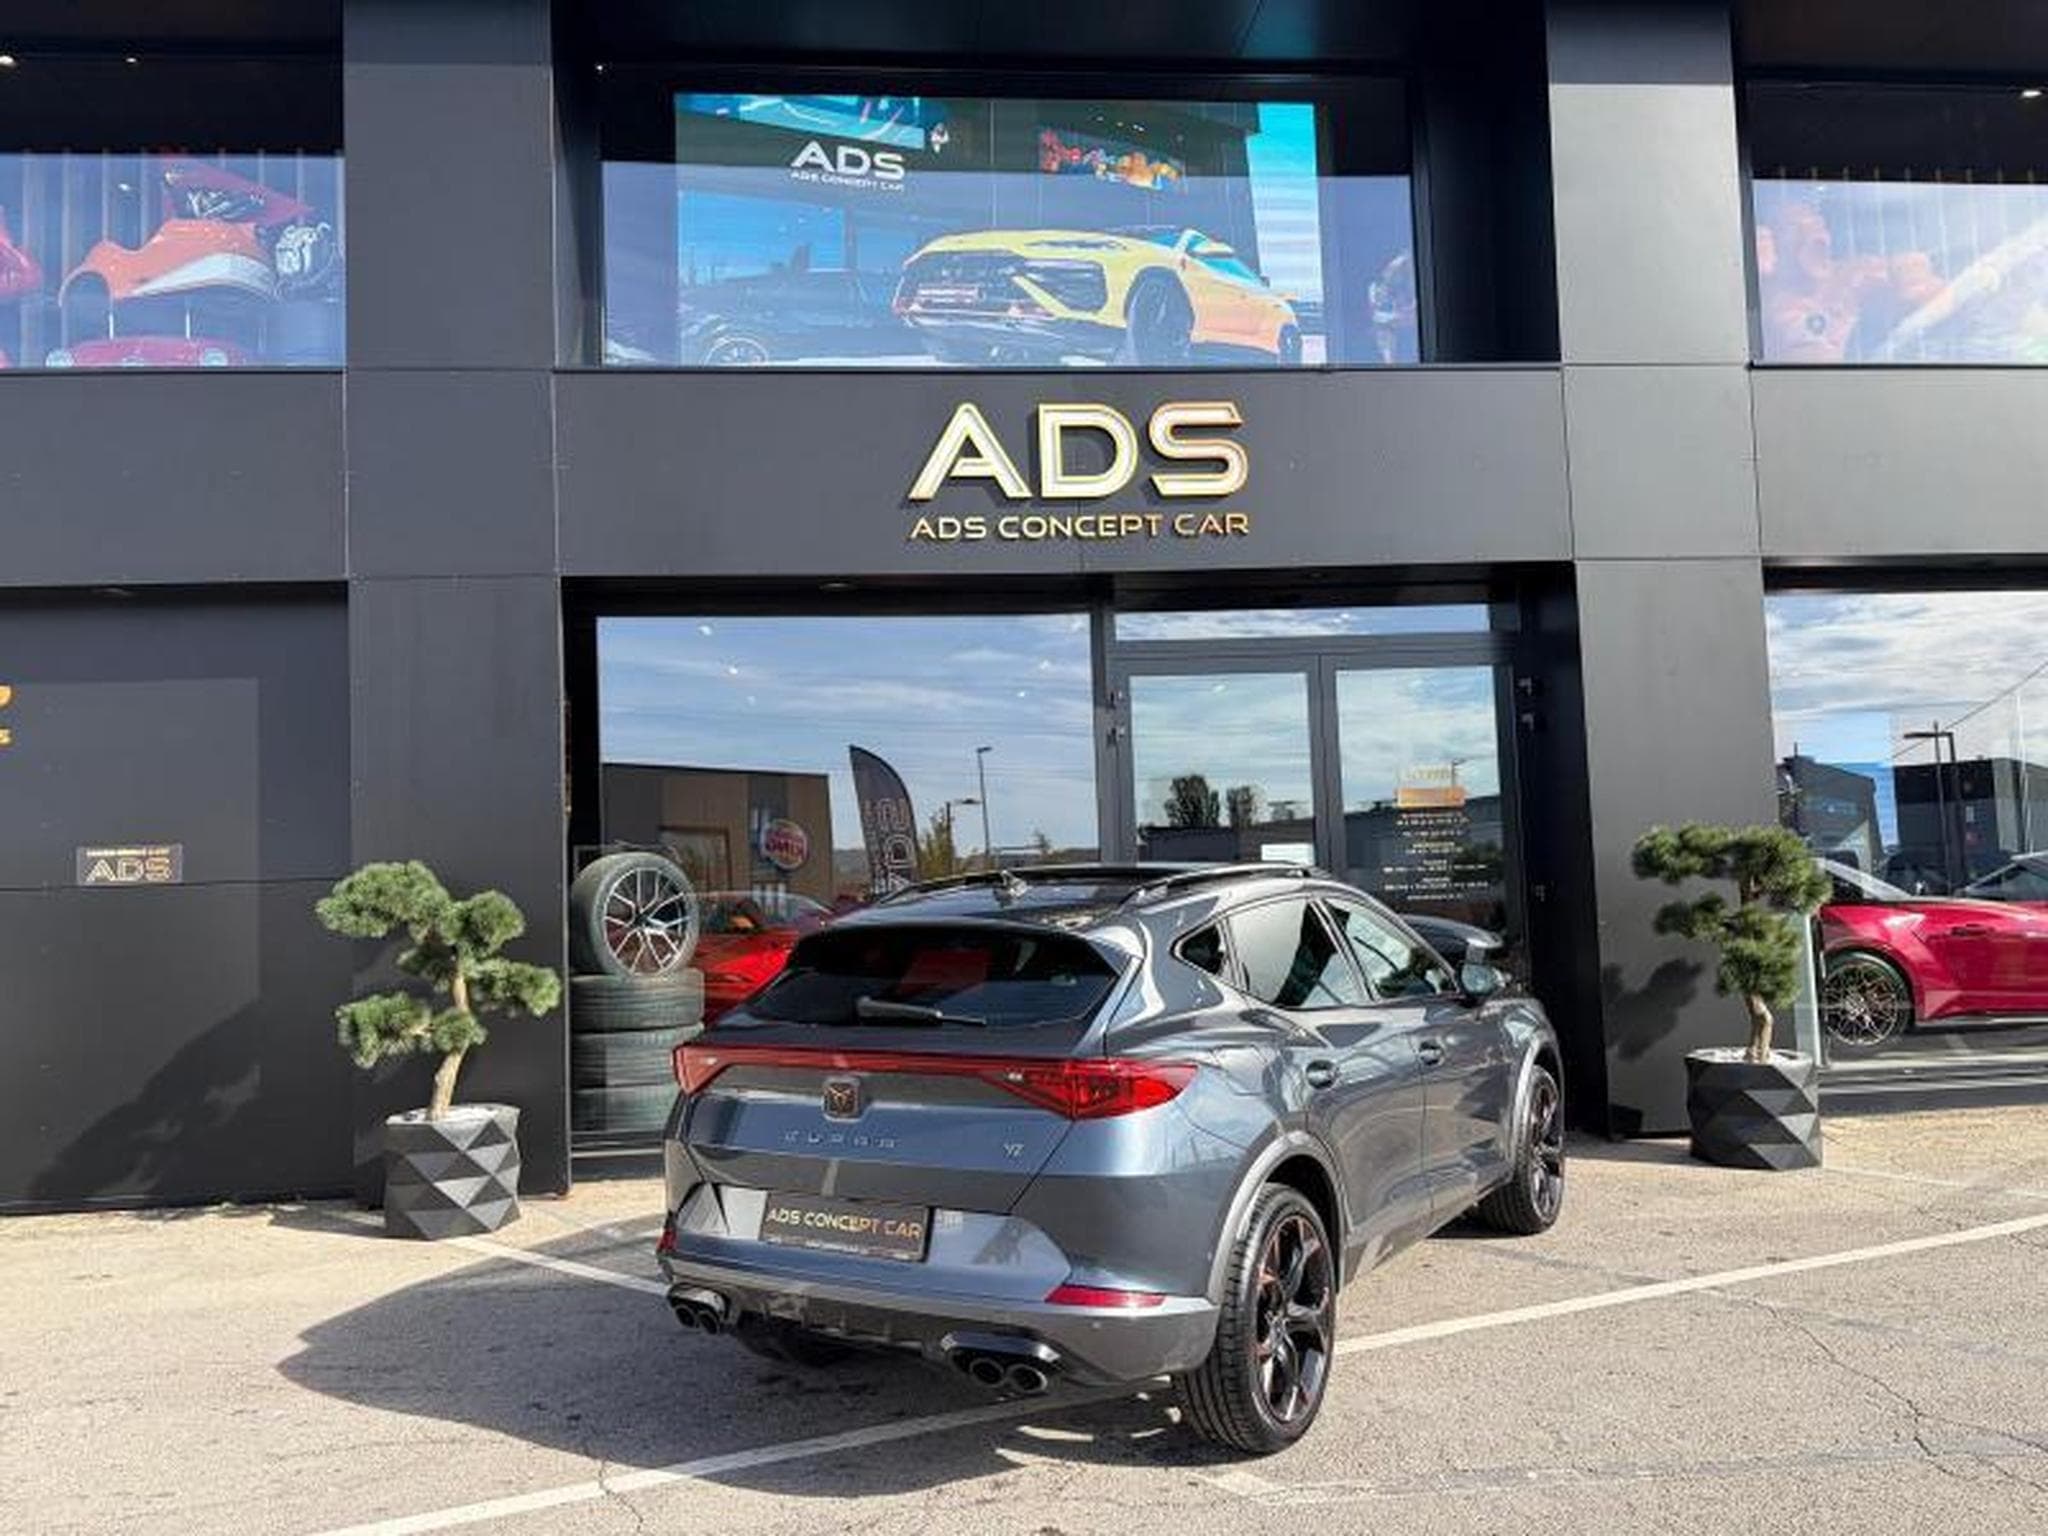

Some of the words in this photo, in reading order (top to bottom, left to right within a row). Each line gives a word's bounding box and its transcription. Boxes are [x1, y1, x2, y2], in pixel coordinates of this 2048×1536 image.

[790, 140, 905, 180] ADS
[908, 401, 1249, 500] ADS
[910, 516, 987, 539] ADS
[999, 514, 1164, 539] CONCEPT
[1174, 512, 1250, 536] CAR
[84, 858, 172, 884] ADS
[765, 1207, 802, 1226] ADS
[804, 1211, 880, 1234] CONCEPT
[883, 1219, 923, 1239] CAR
